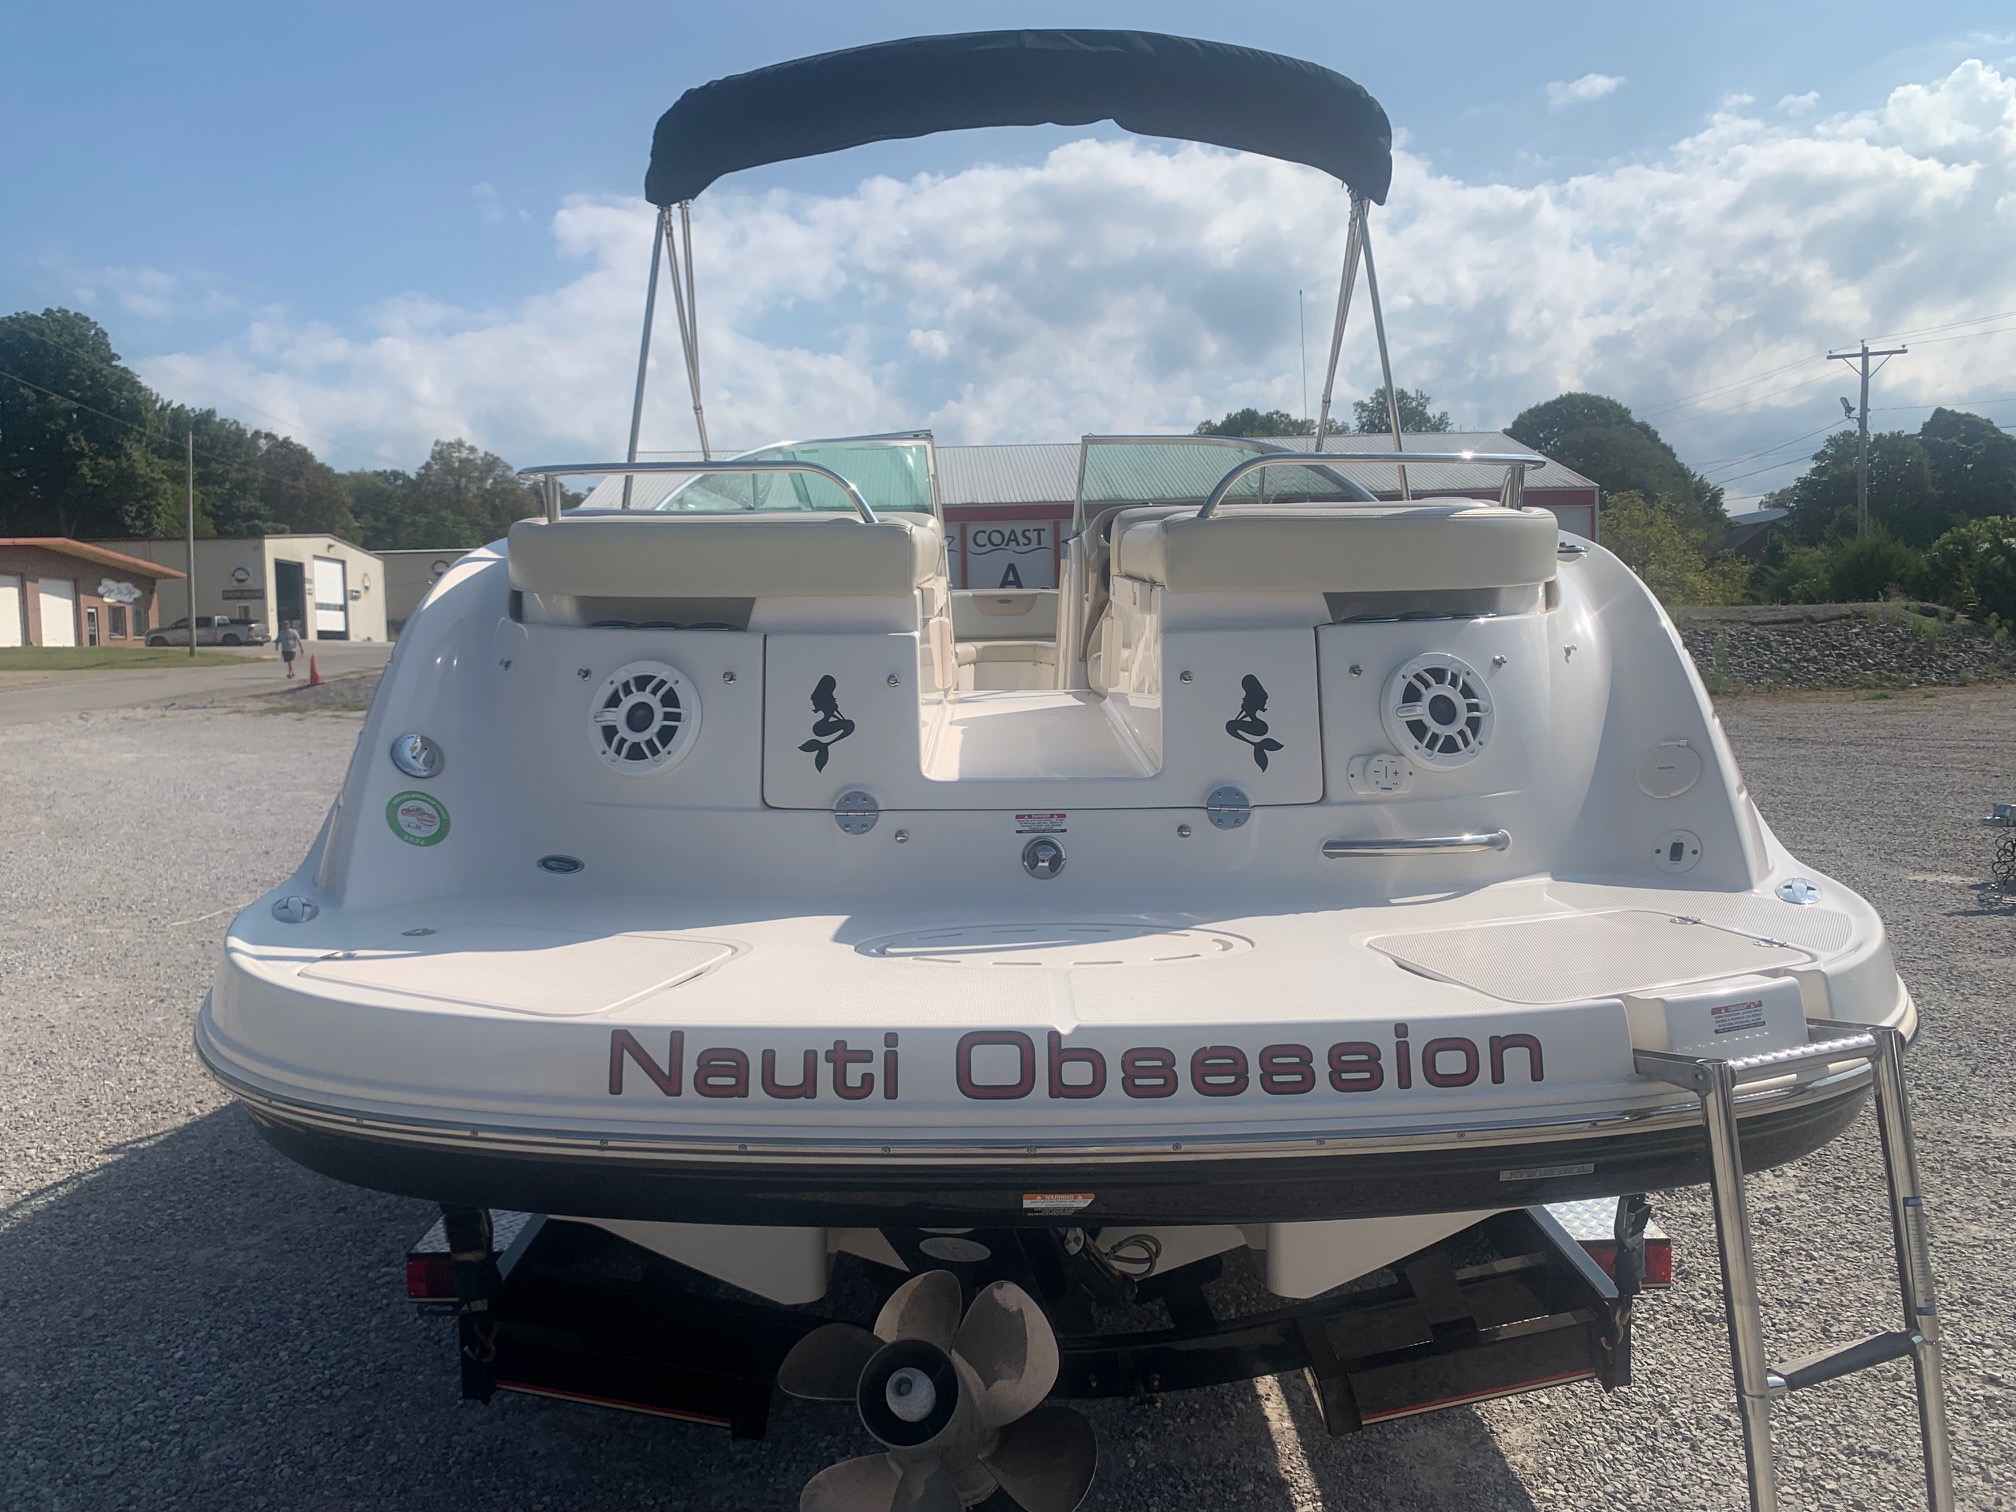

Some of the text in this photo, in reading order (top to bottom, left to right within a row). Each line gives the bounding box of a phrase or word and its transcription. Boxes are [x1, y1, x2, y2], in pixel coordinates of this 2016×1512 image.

[972, 528, 1046, 548] COAST
[1000, 562, 1025, 589] A
[608, 1022, 1545, 1101] Nauti Obsession
